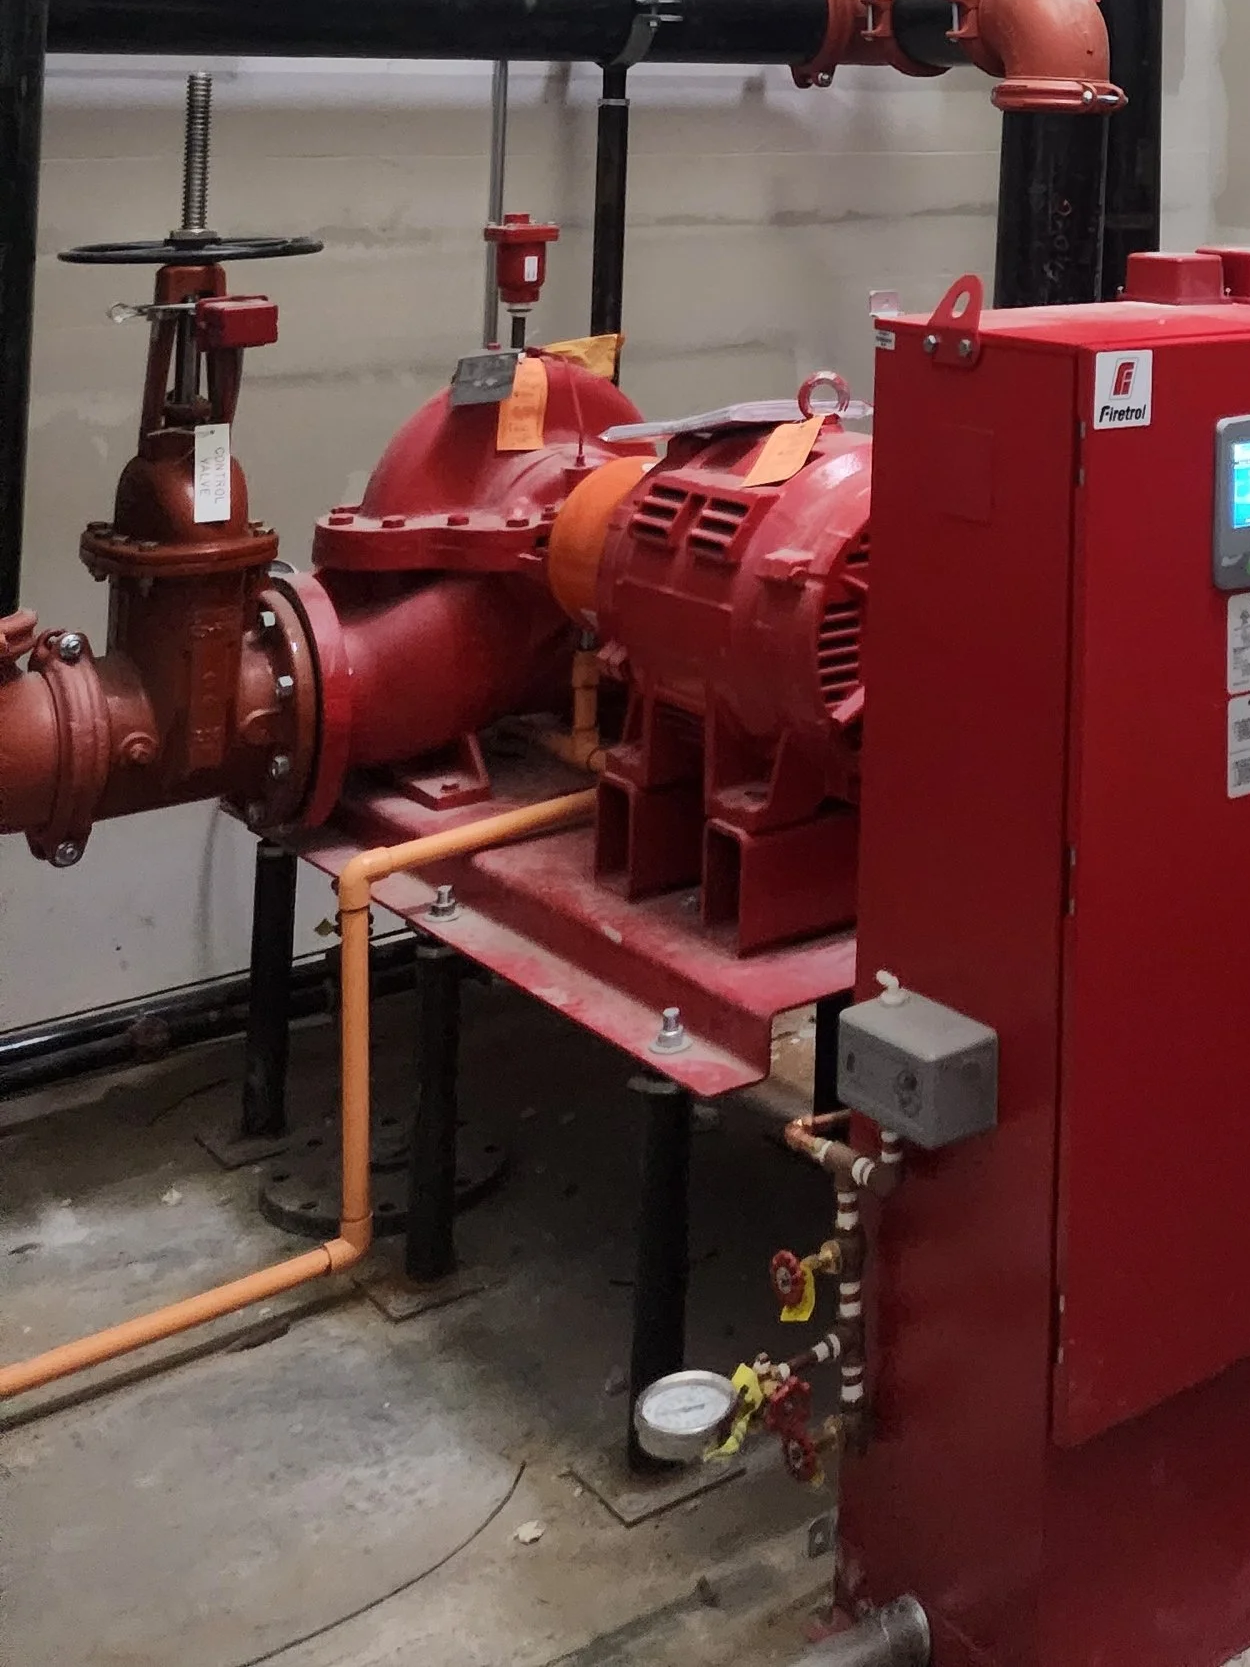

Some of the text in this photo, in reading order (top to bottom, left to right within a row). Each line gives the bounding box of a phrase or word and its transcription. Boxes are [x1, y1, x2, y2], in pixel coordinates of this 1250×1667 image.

[1099, 404, 1147, 423] Firetrol
[199, 458, 211, 496] VALVE
[214, 446, 225, 504] CONTROL
